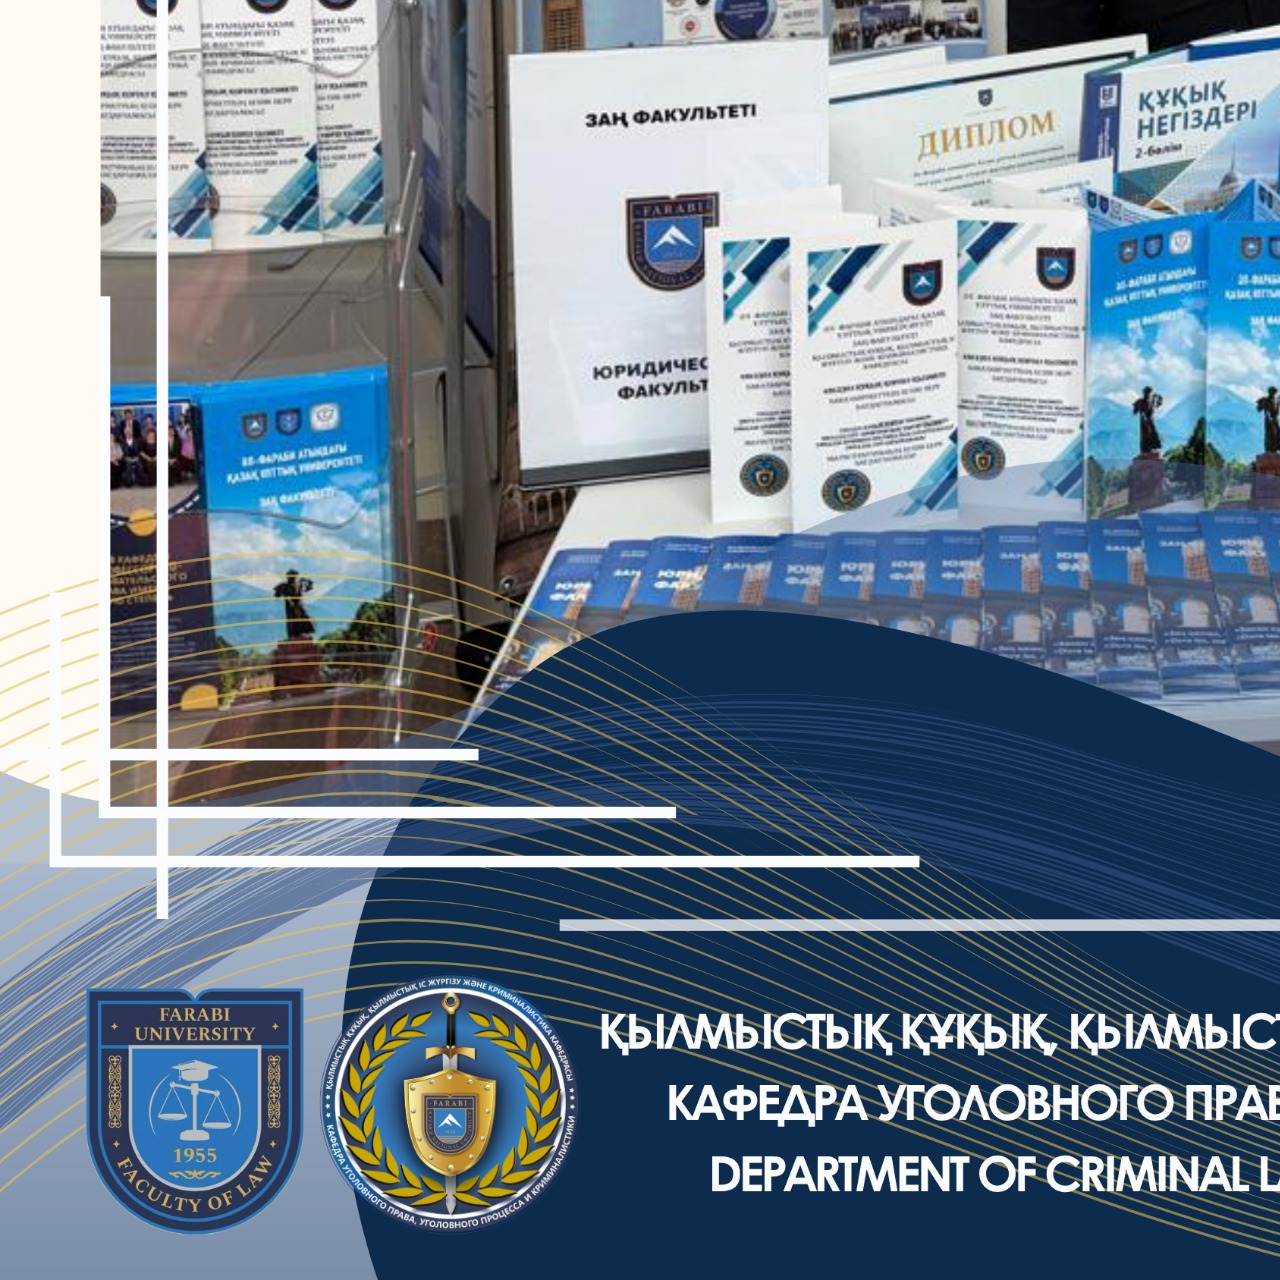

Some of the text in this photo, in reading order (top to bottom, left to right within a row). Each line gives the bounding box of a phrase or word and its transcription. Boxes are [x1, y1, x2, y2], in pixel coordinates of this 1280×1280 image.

[1139, 79, 1228, 113] ҚҰҚЫҚ
[585, 103, 757, 130] ЗАҢ ФАКУЛЬТЕТІ
[1137, 101, 1257, 140] НЕГІЗДЕРІ
[917, 111, 1055, 162] ДИПЛОМ
